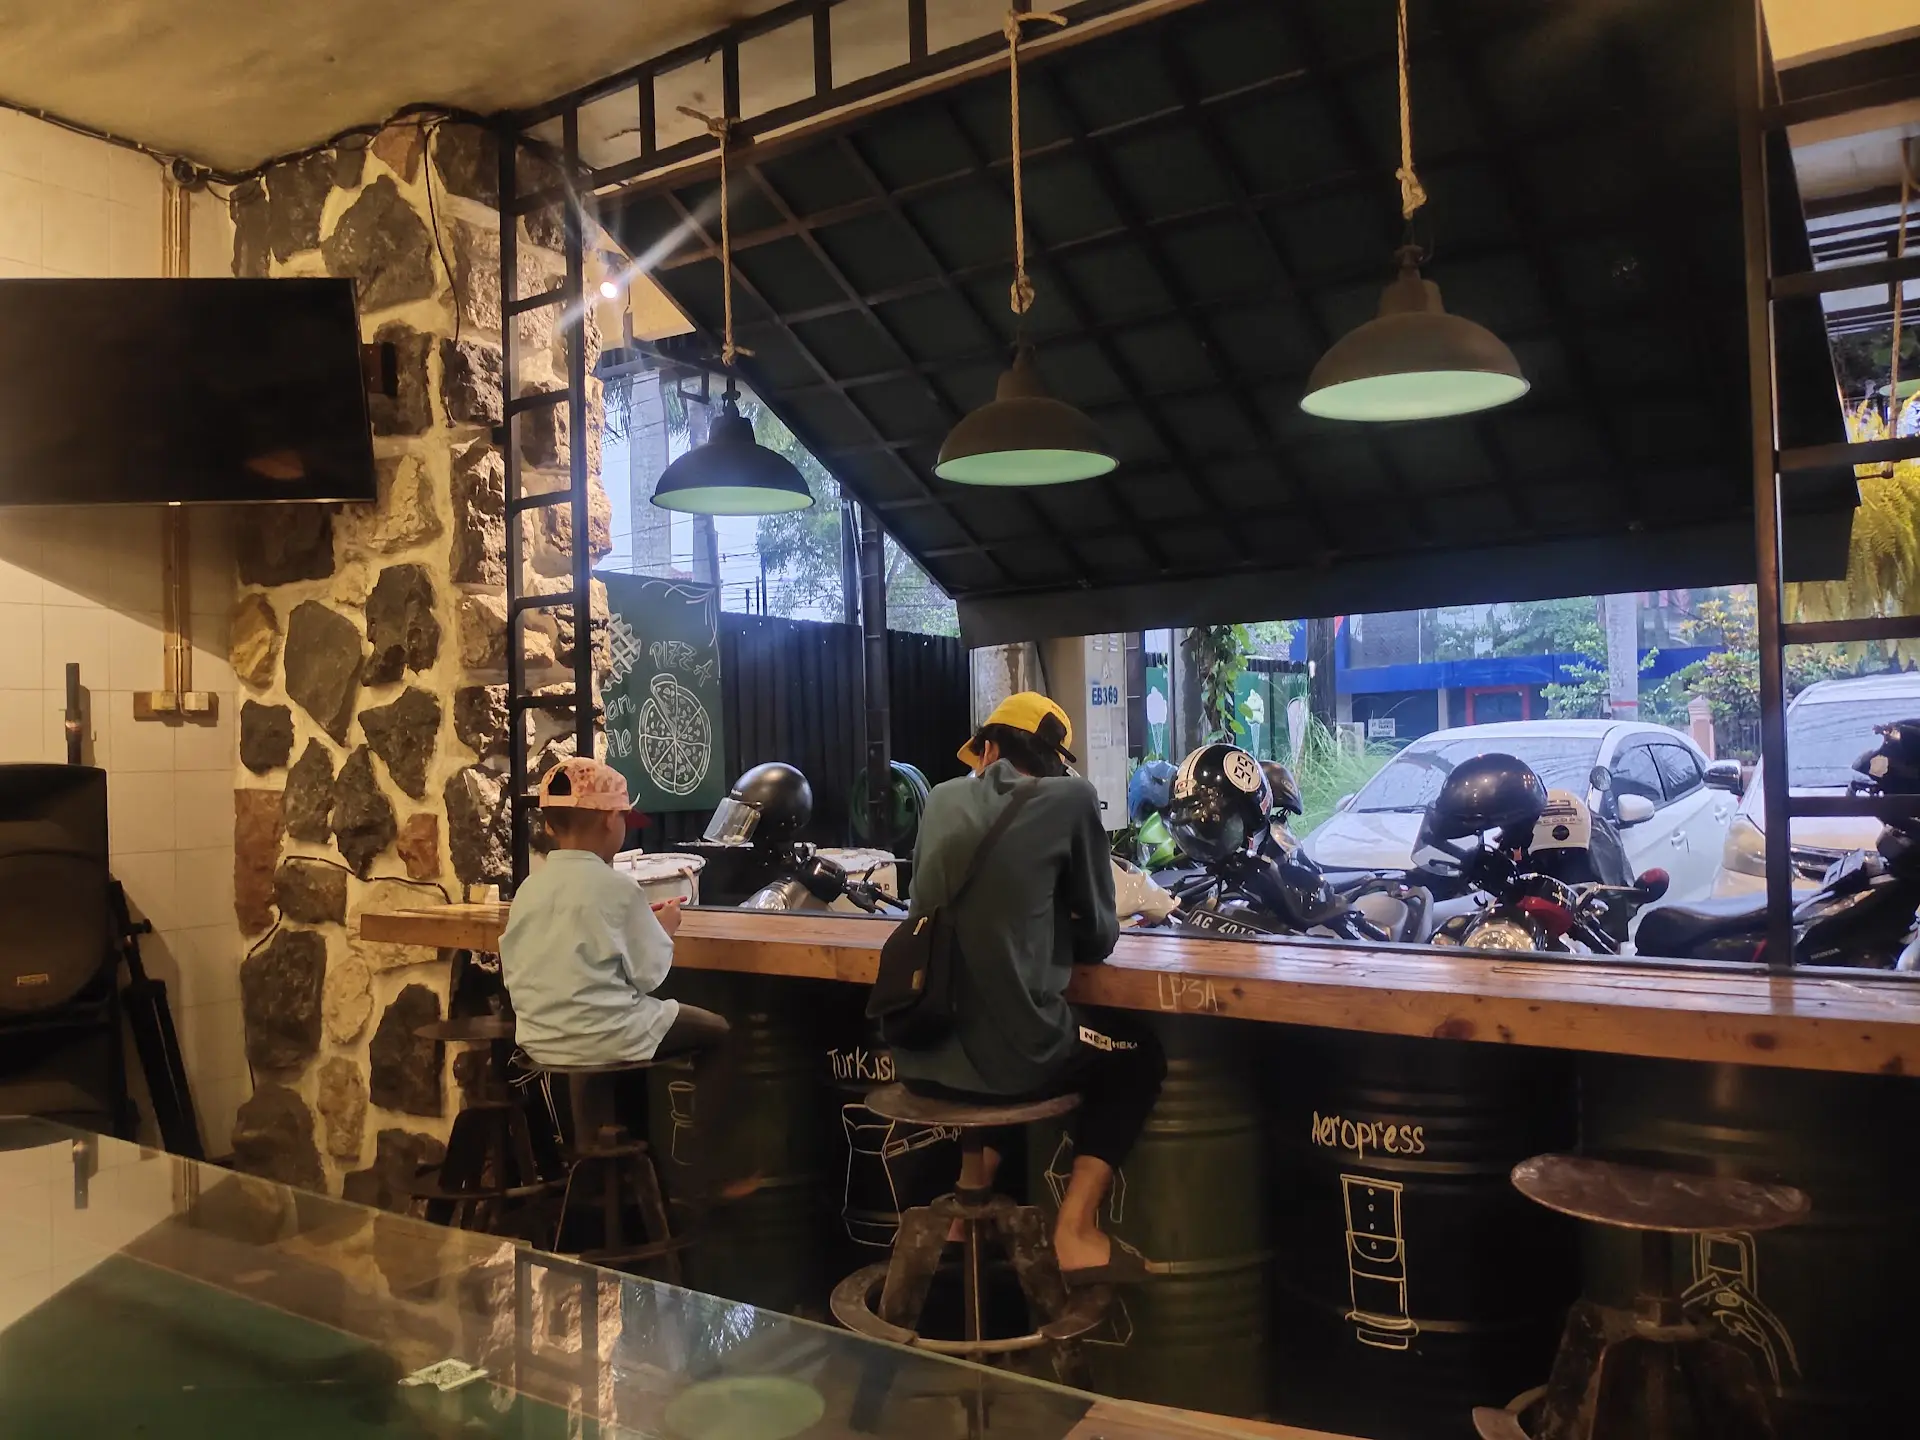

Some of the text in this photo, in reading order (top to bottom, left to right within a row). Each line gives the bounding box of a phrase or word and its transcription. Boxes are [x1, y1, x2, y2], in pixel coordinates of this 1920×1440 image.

[649, 640, 713, 687] PIZZA
[607, 694, 636, 721] an
[1092, 685, 1119, 706] EB369
[1192, 913, 1214, 929] AG
[1311, 1110, 1426, 1159] Aeropress
